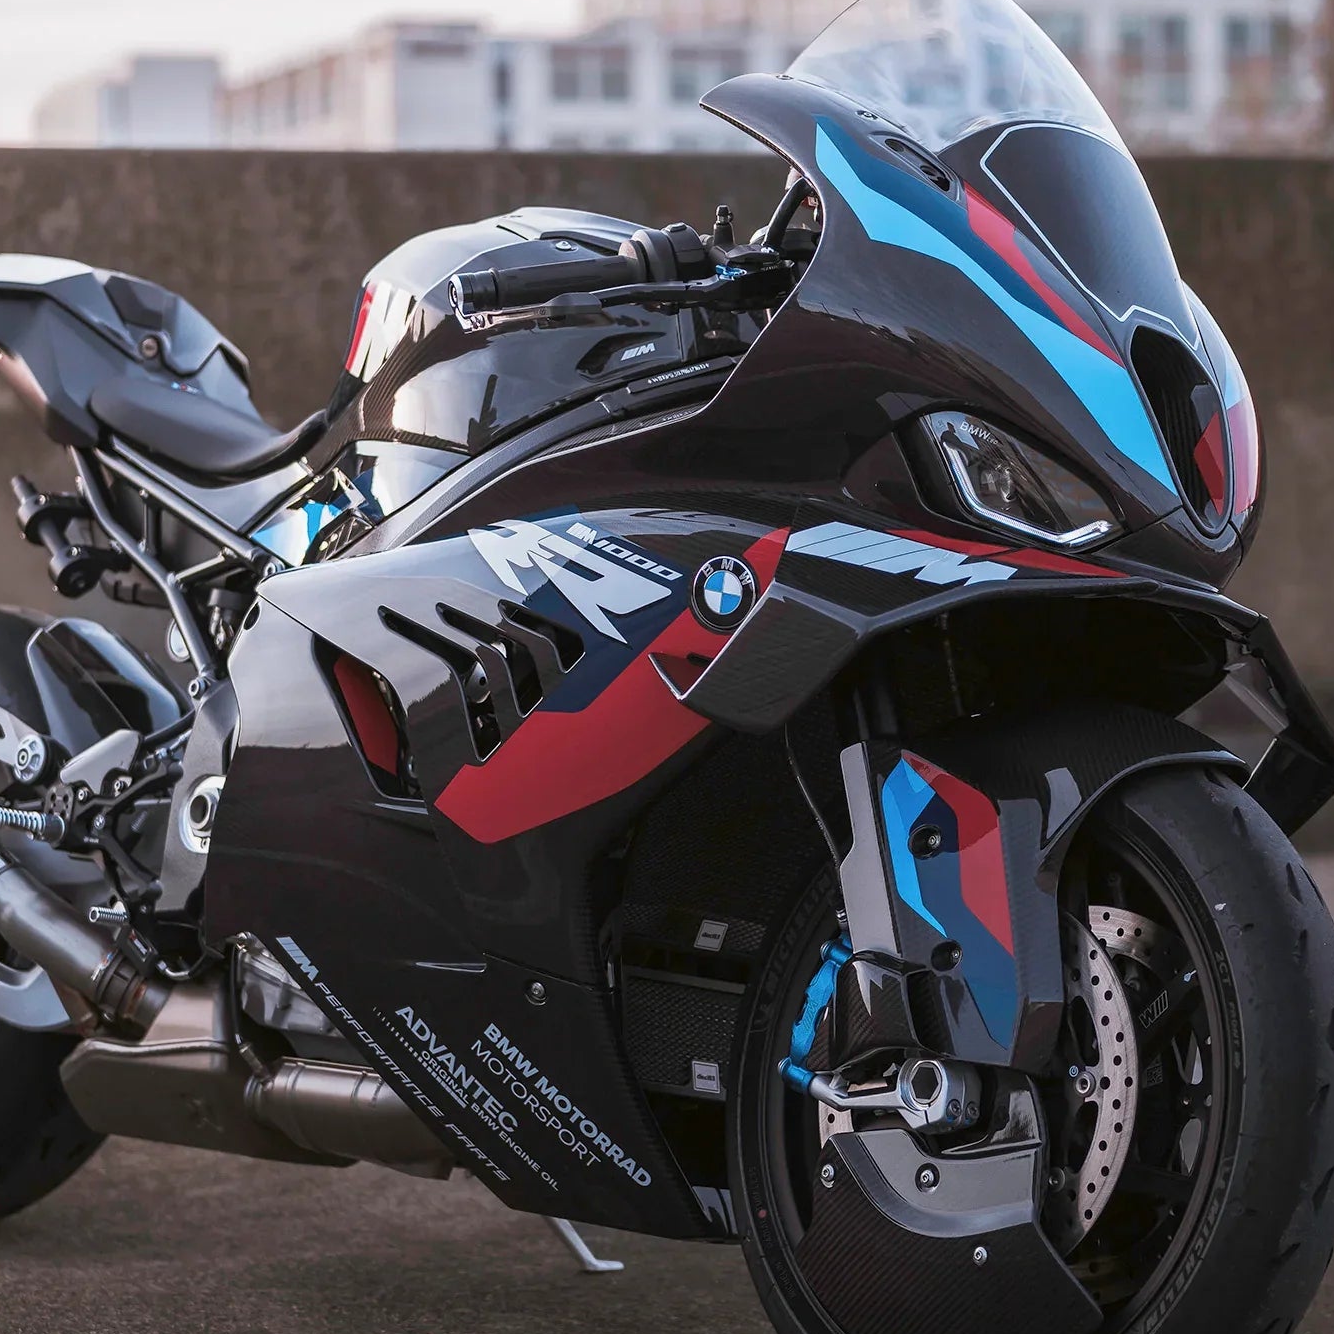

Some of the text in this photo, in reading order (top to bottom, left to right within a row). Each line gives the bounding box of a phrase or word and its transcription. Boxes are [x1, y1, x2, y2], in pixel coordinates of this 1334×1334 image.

[960, 421, 991, 440] BMW
[701, 558, 752, 586] BMW
[314, 982, 446, 1118] PERFORMANCE
[445, 1123, 512, 1182] PARTS
[395, 1006, 519, 1133] ADVANTEC
[421, 1050, 559, 1192] ORIGINAL BMW ENGINE OIL
[470, 1039, 601, 1167] MOTORSPORT
[483, 1022, 653, 1187] BMW MOTORRAD
[1145, 1196, 1220, 1333] MICHELIN
